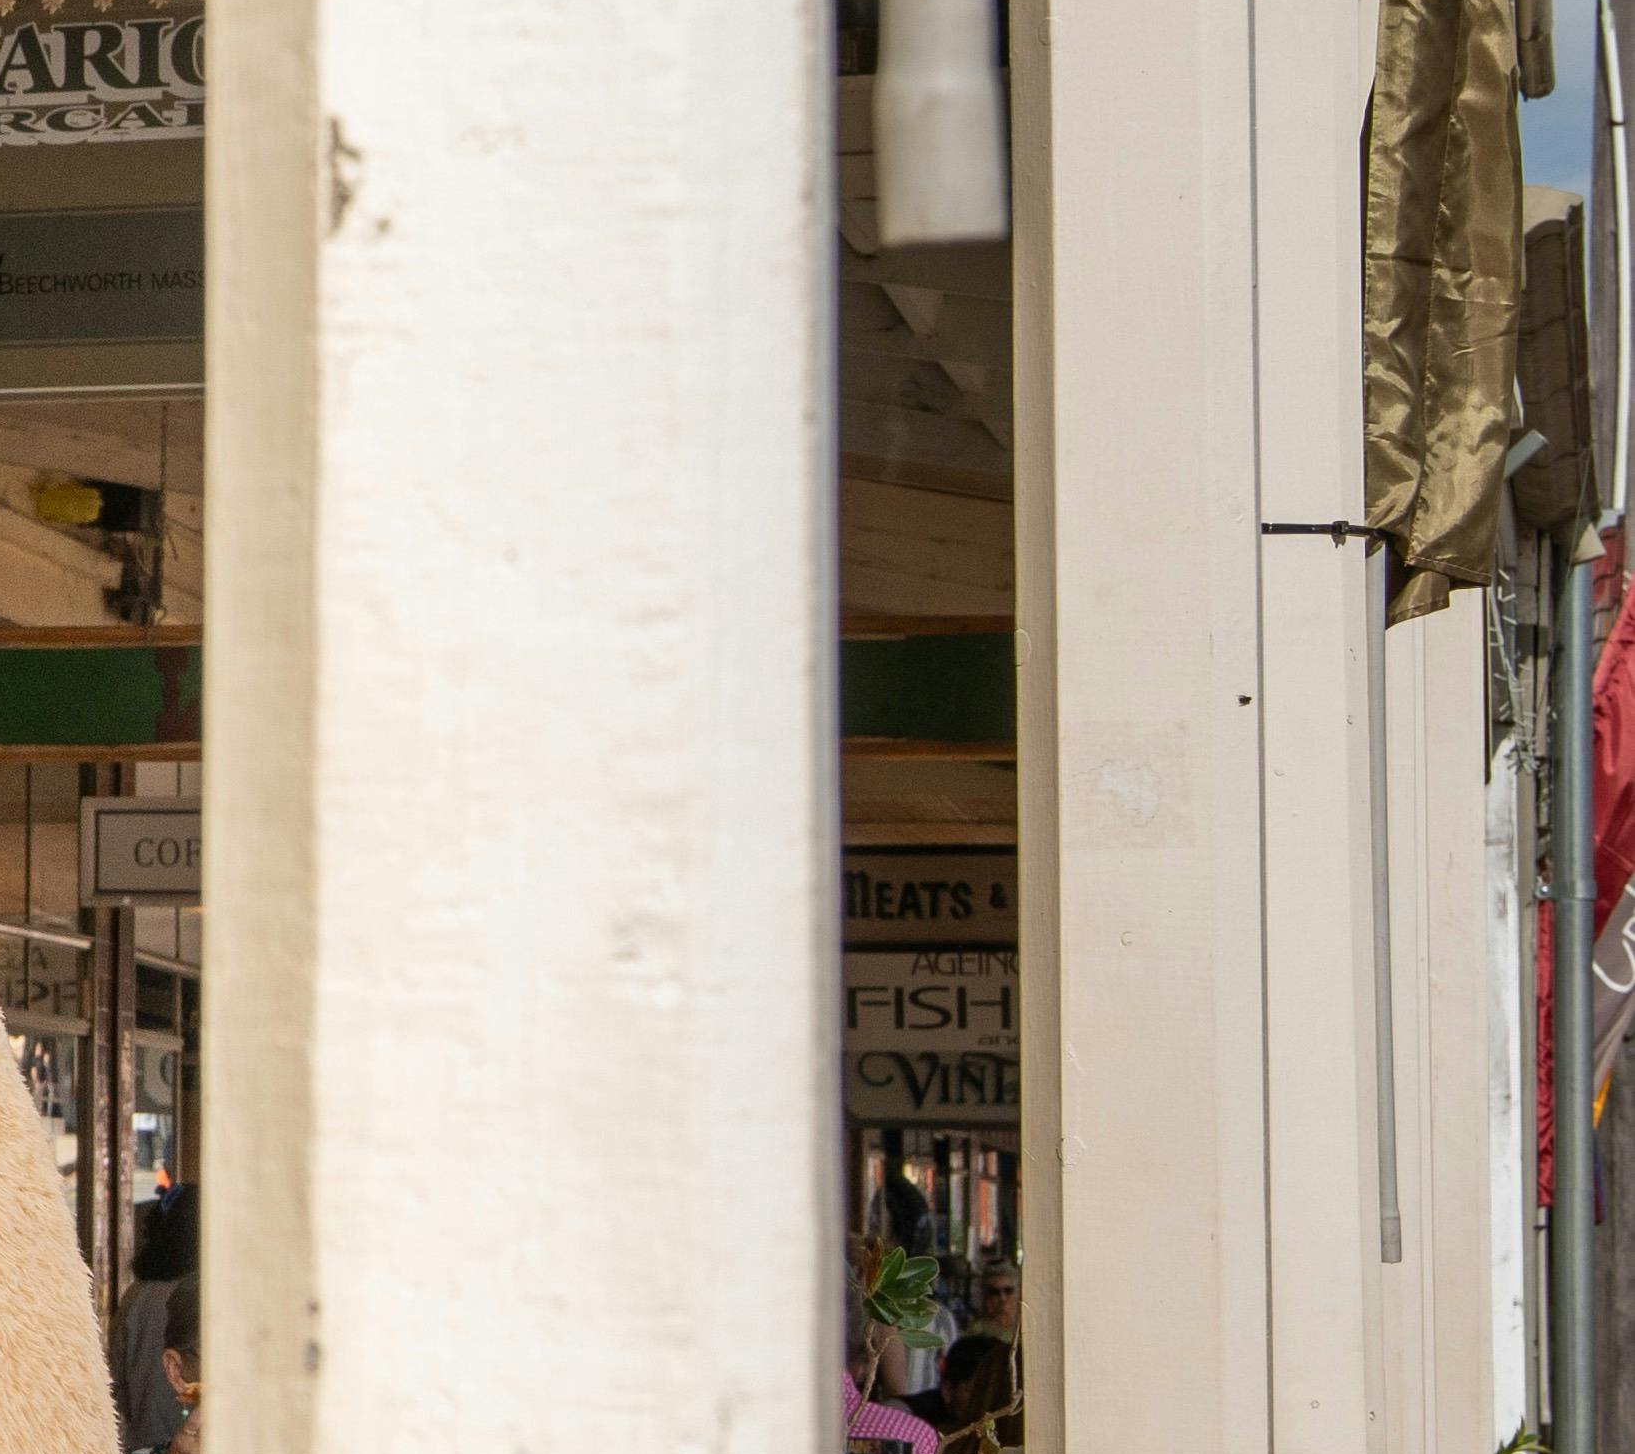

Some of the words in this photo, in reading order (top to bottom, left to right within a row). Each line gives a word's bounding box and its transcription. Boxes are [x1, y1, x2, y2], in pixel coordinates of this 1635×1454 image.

[911, 951, 1019, 977] AGEIN
[847, 985, 1012, 1029] FISH
[858, 1051, 1019, 1110] VINT
